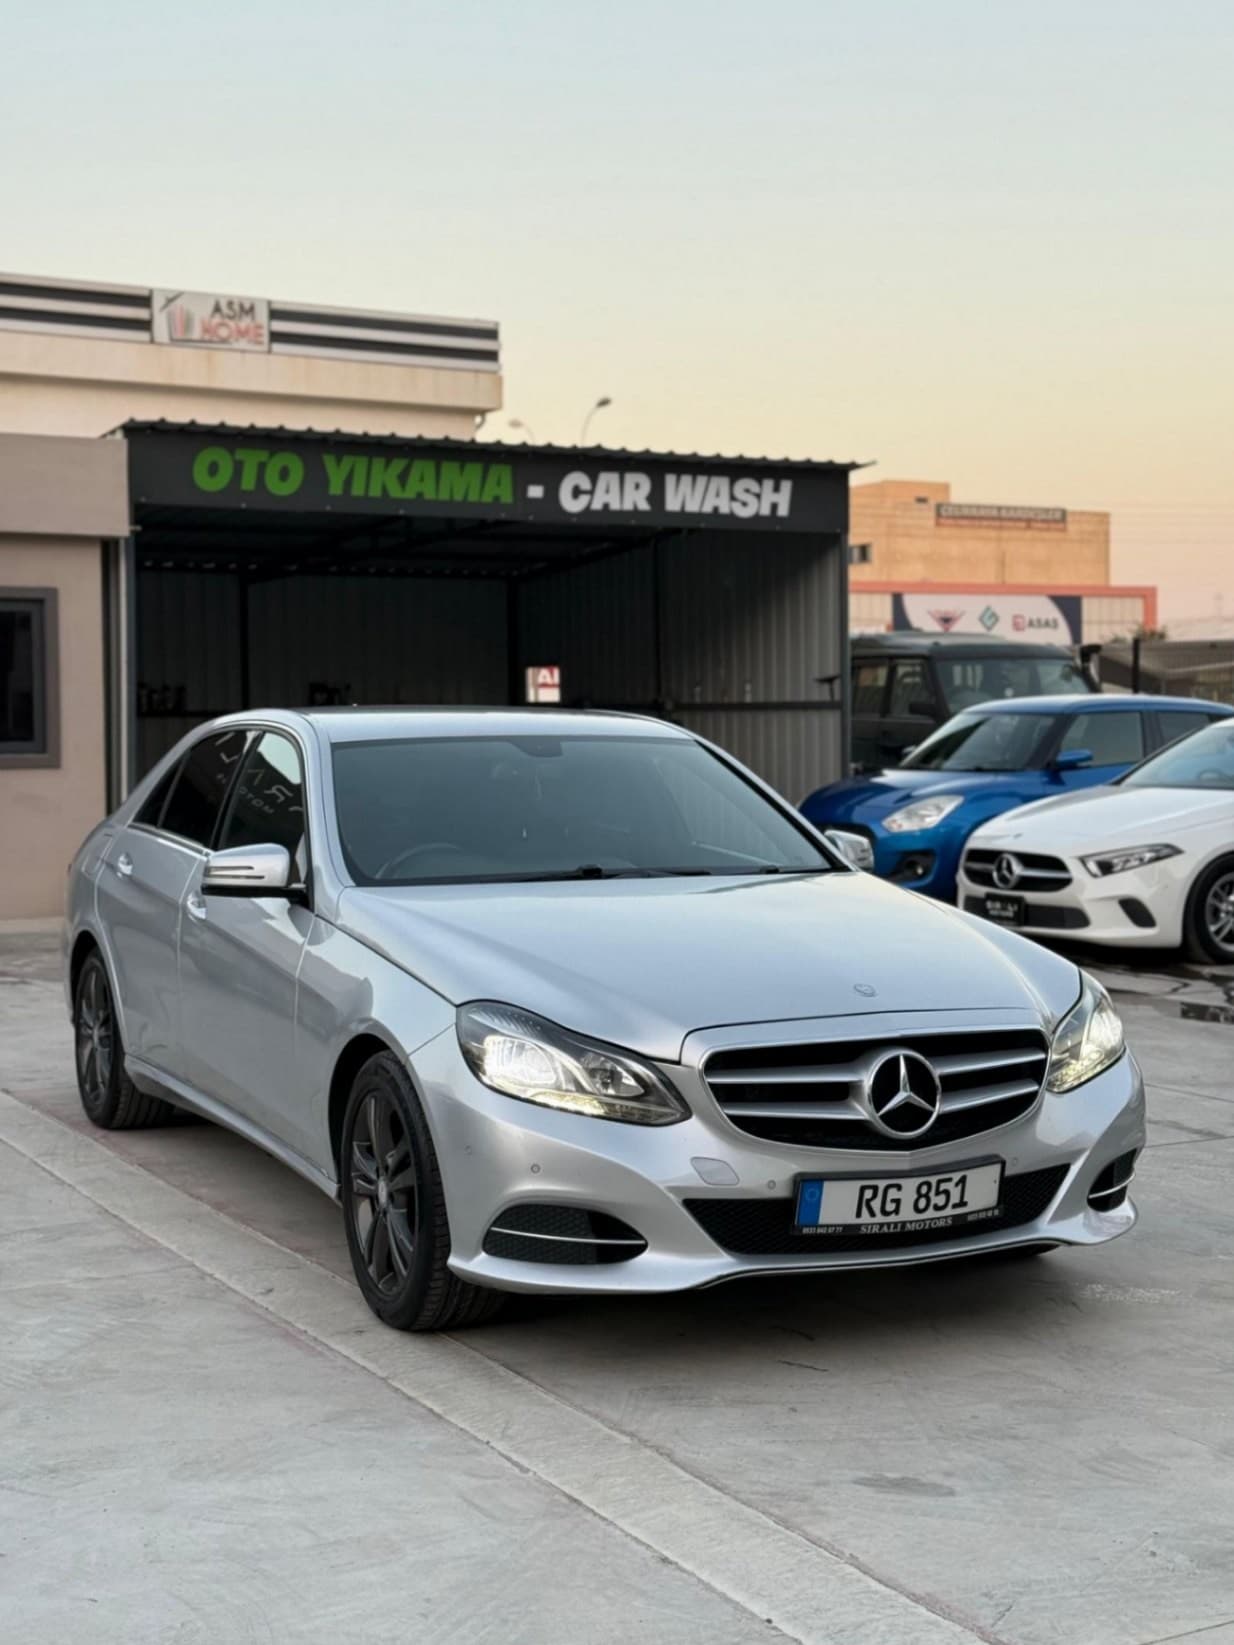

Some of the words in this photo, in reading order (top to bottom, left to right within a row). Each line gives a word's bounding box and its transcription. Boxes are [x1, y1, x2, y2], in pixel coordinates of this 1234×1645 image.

[210, 299, 255, 322] ASM
[201, 319, 264, 346] HOME
[192, 446, 304, 496] OTO
[323, 454, 514, 504] YIKAMA
[527, 485, 544, 498] -
[558, 471, 652, 513] CAR
[664, 473, 793, 518] WASH
[855, 1183, 902, 1218] RG
[913, 1174, 969, 1214] 851
[859, 1222, 902, 1234] SIRALI
[904, 1217, 953, 1233] MOTORS
